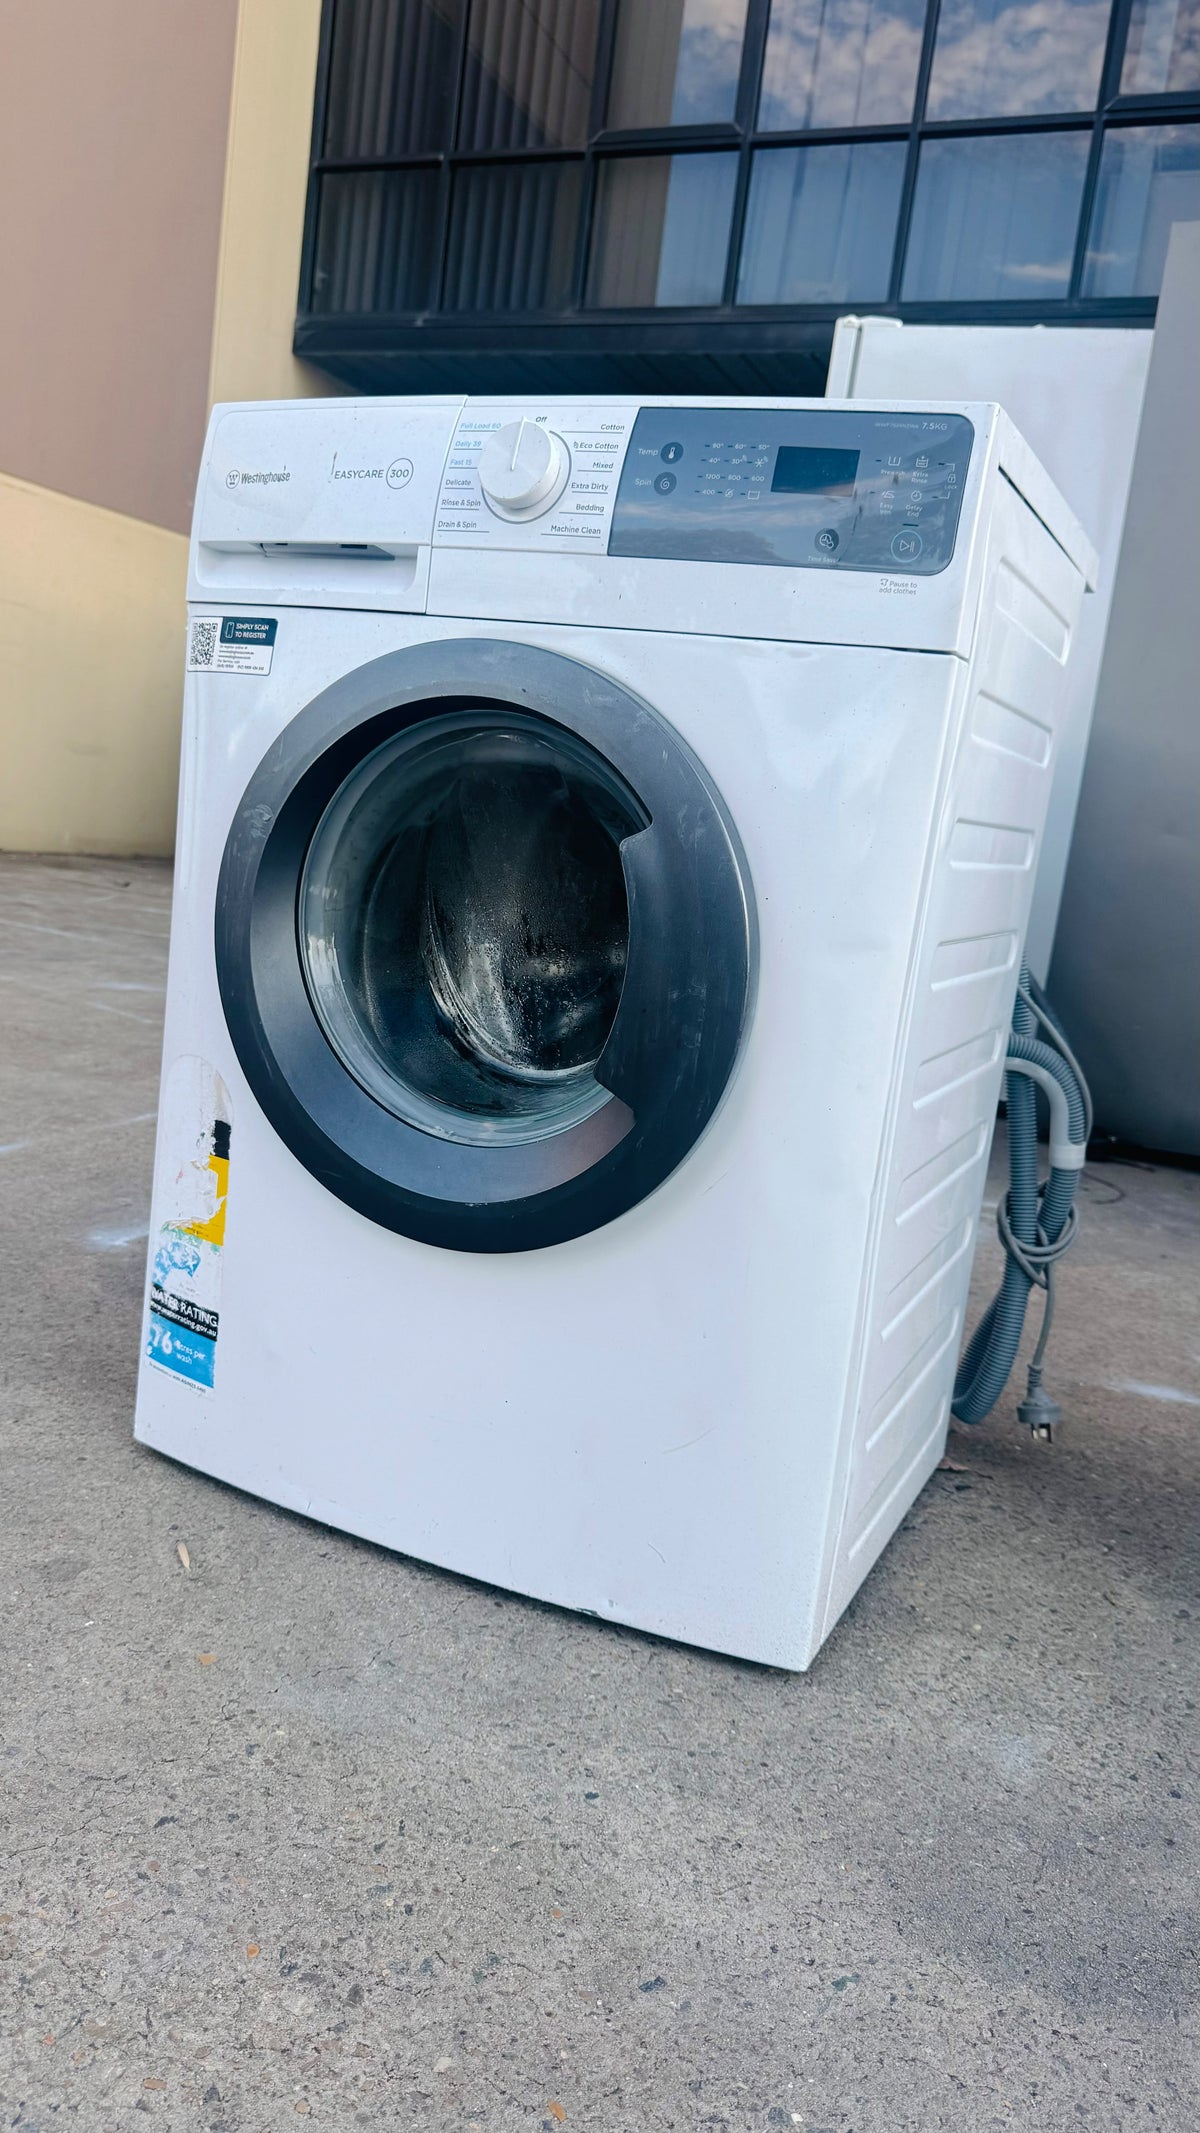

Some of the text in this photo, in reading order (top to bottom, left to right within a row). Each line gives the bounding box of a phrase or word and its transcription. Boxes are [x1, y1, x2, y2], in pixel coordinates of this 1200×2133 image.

[921, 422, 948, 431] 7.5KG
[455, 441, 471, 449] Daily
[594, 442, 619, 450] Cotton
[638, 448, 659, 457] Temp
[241, 471, 291, 486] Westinghouse
[334, 469, 410, 480] EASYCARE 300
[591, 483, 608, 491] Dirty
[634, 478, 652, 487] Spin
[466, 500, 481, 508] Spin
[576, 504, 605, 512] Bedding
[462, 521, 477, 529] Spin
[551, 525, 601, 535] Machine Clean
[889, 581, 909, 589] Pause
[893, 588, 917, 596] clothes
[180, 1302, 219, 1328] RATING
[176, 1353, 193, 1365] wash
[194, 1351, 207, 1361] per
